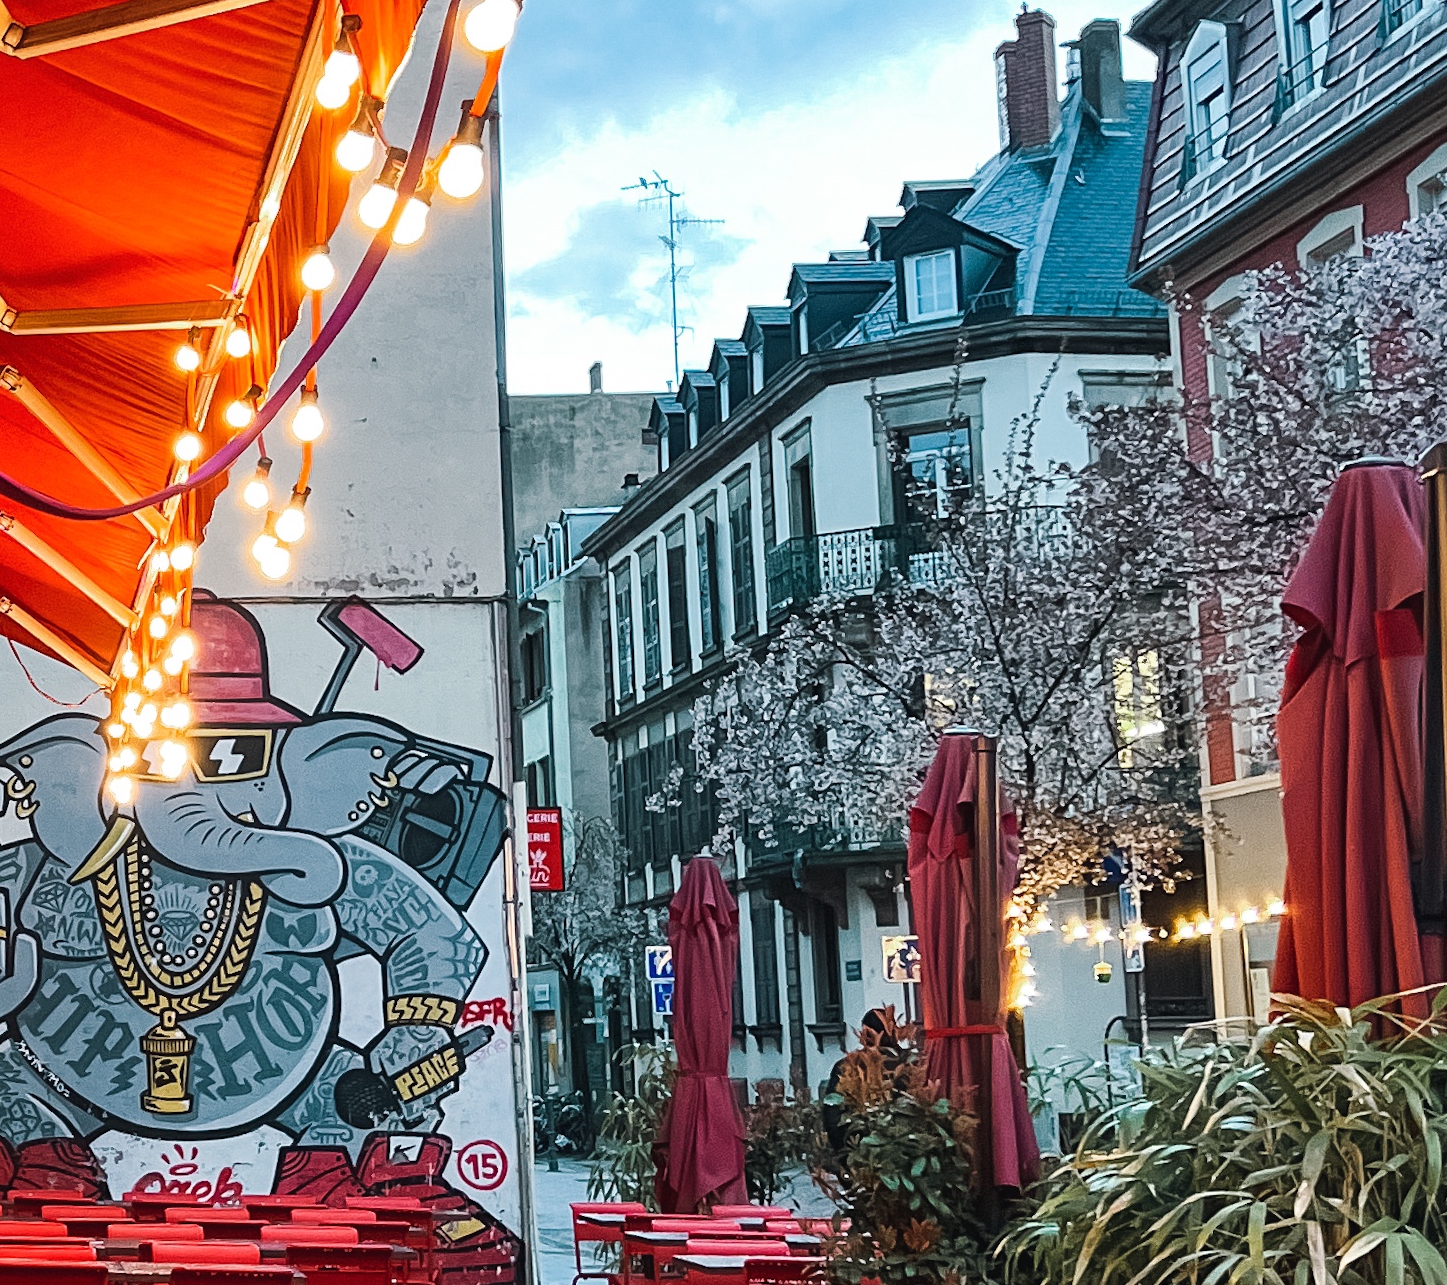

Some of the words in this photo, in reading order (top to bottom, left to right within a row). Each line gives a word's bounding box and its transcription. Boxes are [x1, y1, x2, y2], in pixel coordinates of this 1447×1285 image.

[24, 971, 136, 1078] HIP
[194, 954, 328, 1101] HOP
[393, 1046, 460, 1102] PEACE
[464, 1153, 499, 1180] 15
